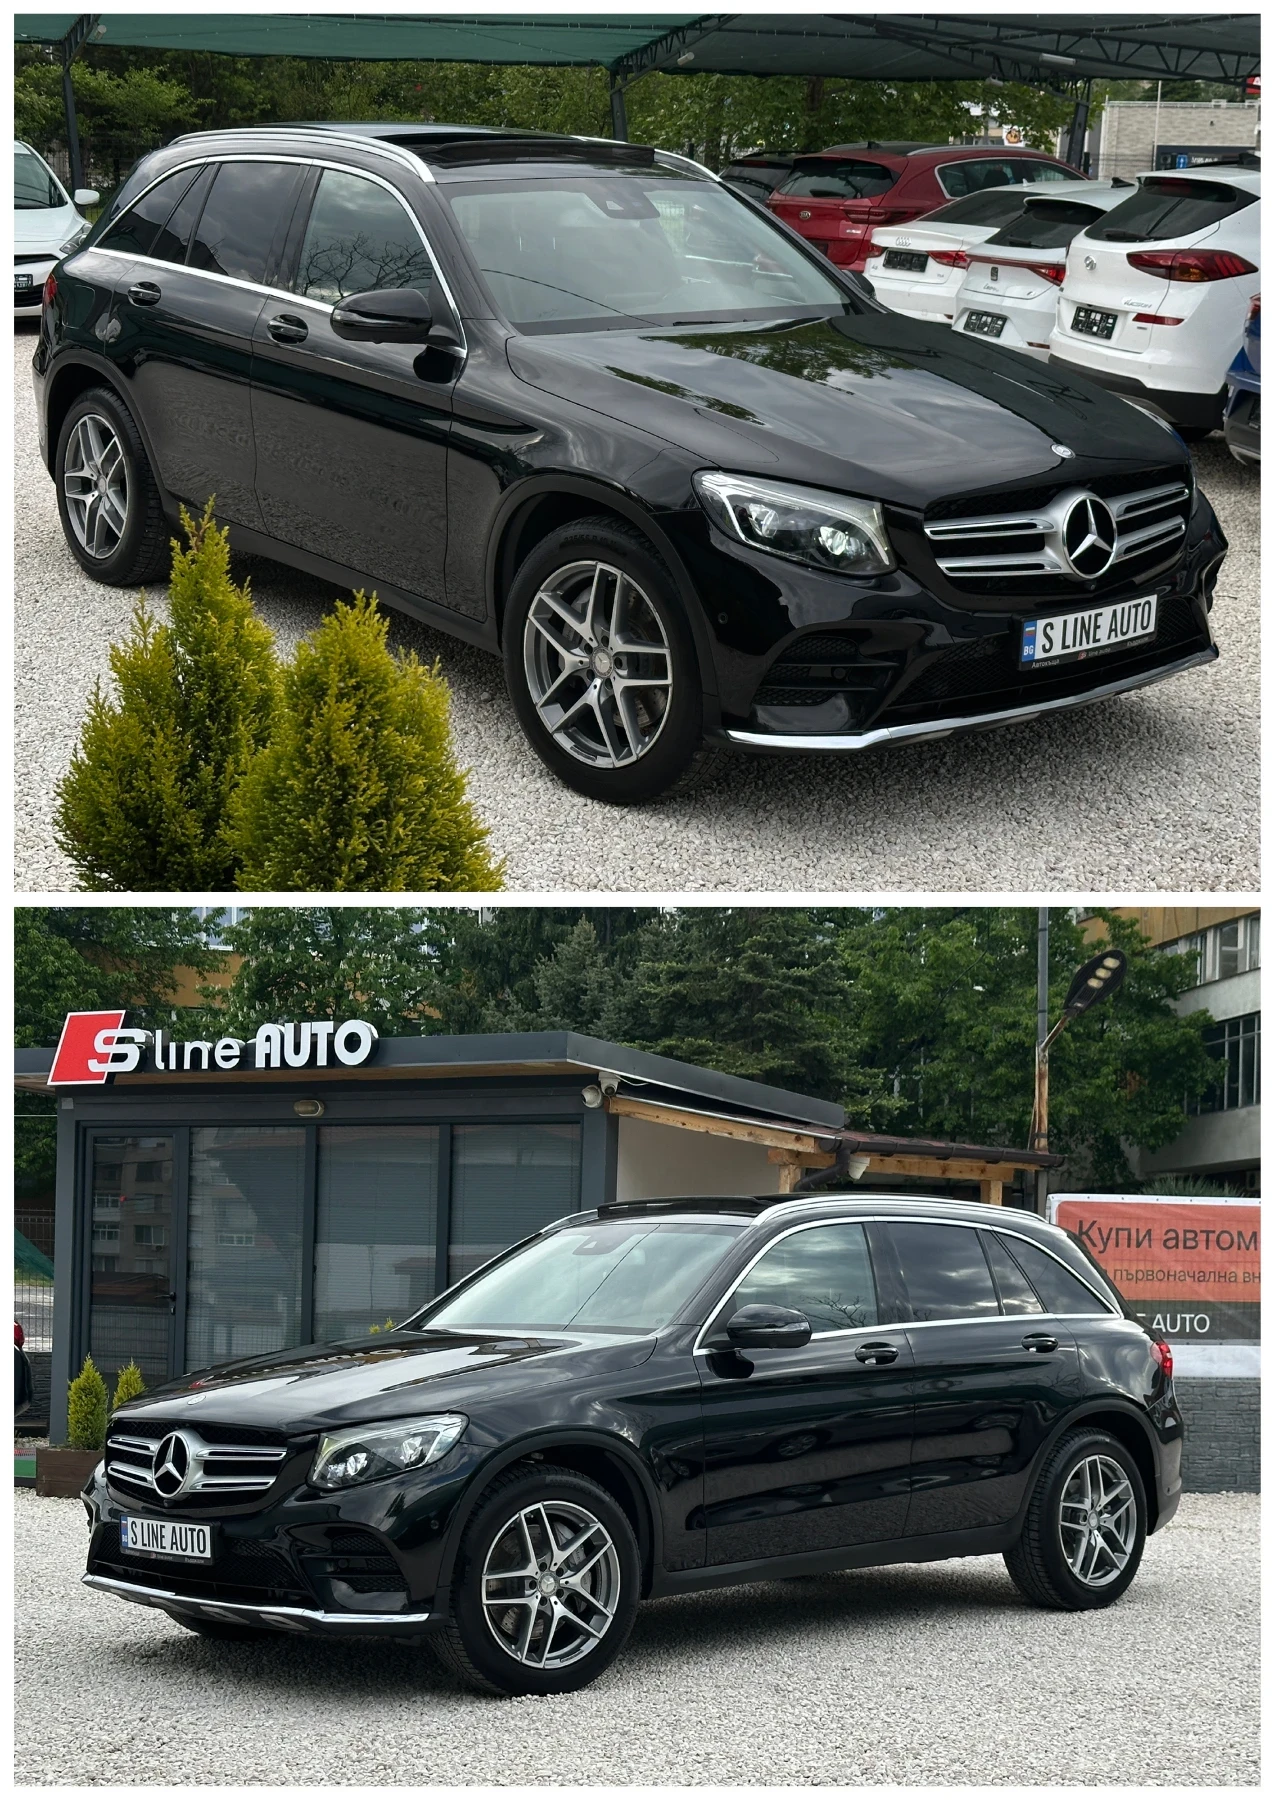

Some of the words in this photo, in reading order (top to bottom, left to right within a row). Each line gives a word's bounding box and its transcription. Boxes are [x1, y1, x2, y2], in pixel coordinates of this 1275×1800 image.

[1042, 621, 1054, 654] S
[1061, 612, 1103, 650] LINE
[1107, 599, 1152, 640] AUTO
[1023, 645, 1034, 655] BG
[1031, 659, 1060, 668] Автокъща
[155, 1029, 241, 1070] line
[255, 1019, 373, 1068] AUTO
[1077, 1219, 1153, 1254] Купи
[1162, 1228, 1258, 1251] автом
[1113, 1269, 1238, 1283] първоначална
[1152, 1313, 1211, 1333] AUTO
[131, 1520, 138, 1546] S
[141, 1522, 166, 1549] LINE
[170, 1526, 207, 1554] AUTO
